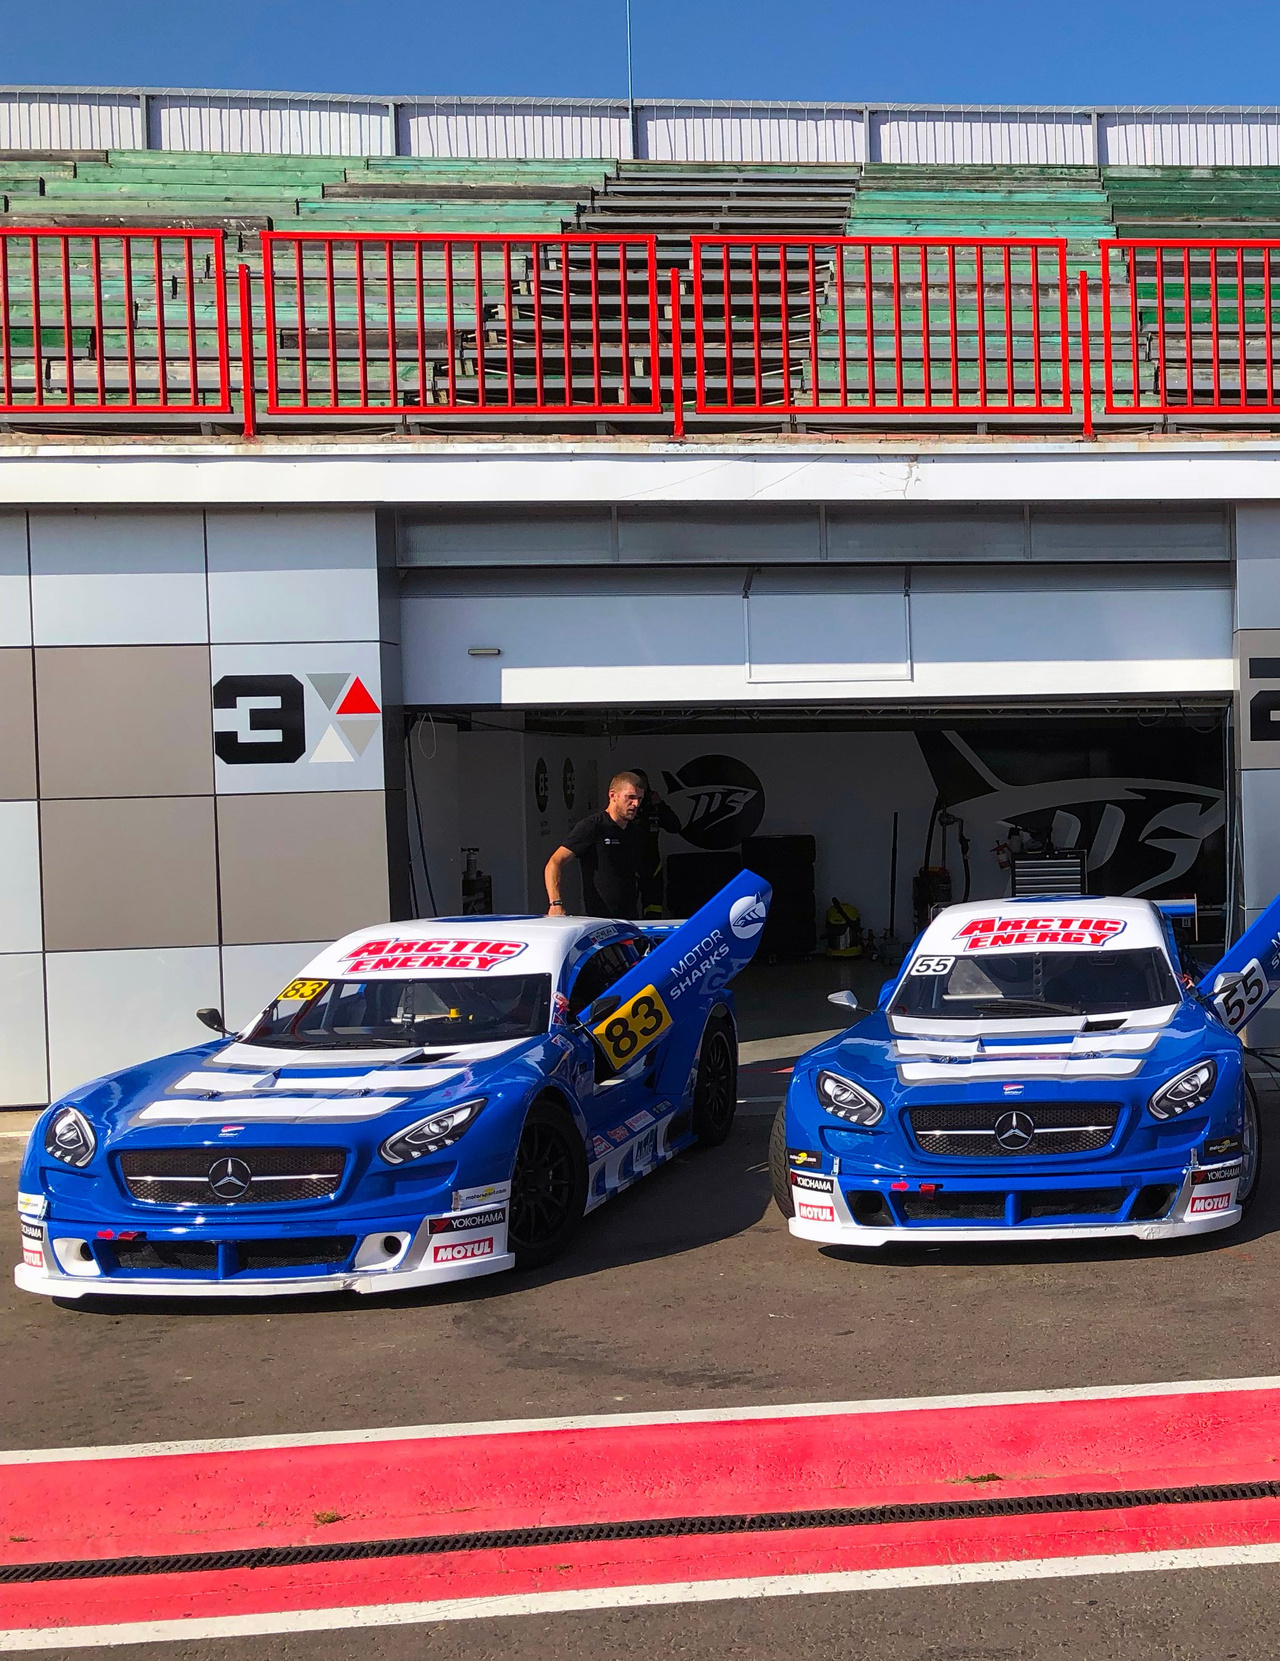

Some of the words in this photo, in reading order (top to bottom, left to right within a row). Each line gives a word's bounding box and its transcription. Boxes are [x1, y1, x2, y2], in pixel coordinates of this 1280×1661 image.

[213, 674, 306, 765] 3
[956, 917, 1123, 937] ARCTIC
[345, 939, 526, 959] ARCTIC
[967, 931, 1115, 950] ENERGY
[670, 928, 724, 978] MOTOR
[348, 954, 502, 973] ENERGY
[669, 943, 730, 1001] SHARKS
[915, 958, 951, 973] 55
[289, 982, 324, 998] 83
[1221, 966, 1264, 1026] 55
[604, 995, 664, 1059] 83
[796, 1176, 832, 1191] YOKOHAMA
[465, 1187, 507, 1201] motorsport.com
[1193, 1195, 1229, 1212] MOTUL
[451, 1211, 504, 1229] YOKOHAMA
[800, 1205, 833, 1221] MOTUL
[436, 1240, 491, 1261] MOTUL
